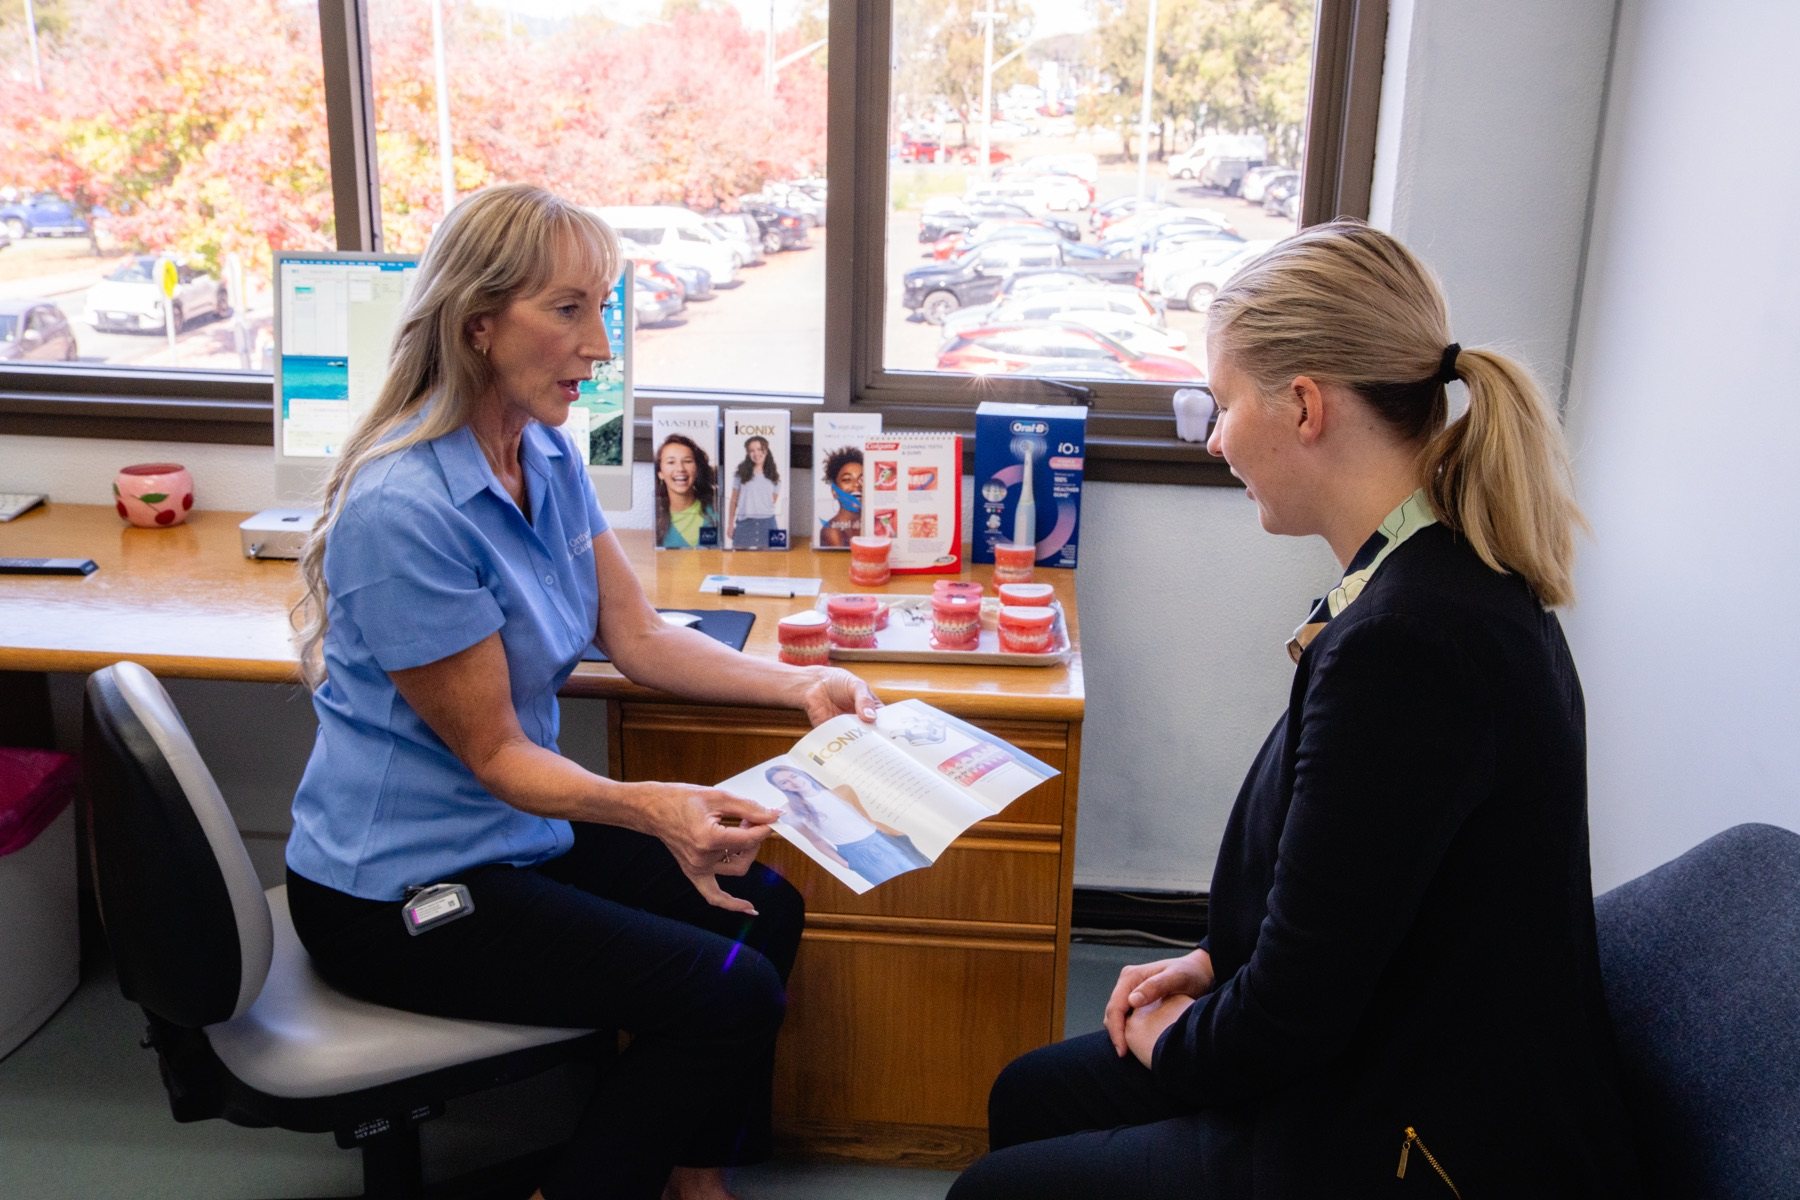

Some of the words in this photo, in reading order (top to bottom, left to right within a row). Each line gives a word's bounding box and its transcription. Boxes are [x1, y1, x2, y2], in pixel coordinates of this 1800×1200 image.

[657, 419, 709, 429] MASTER
[1012, 422, 1046, 434] Oral-B
[865, 442, 896, 451] Colgate
